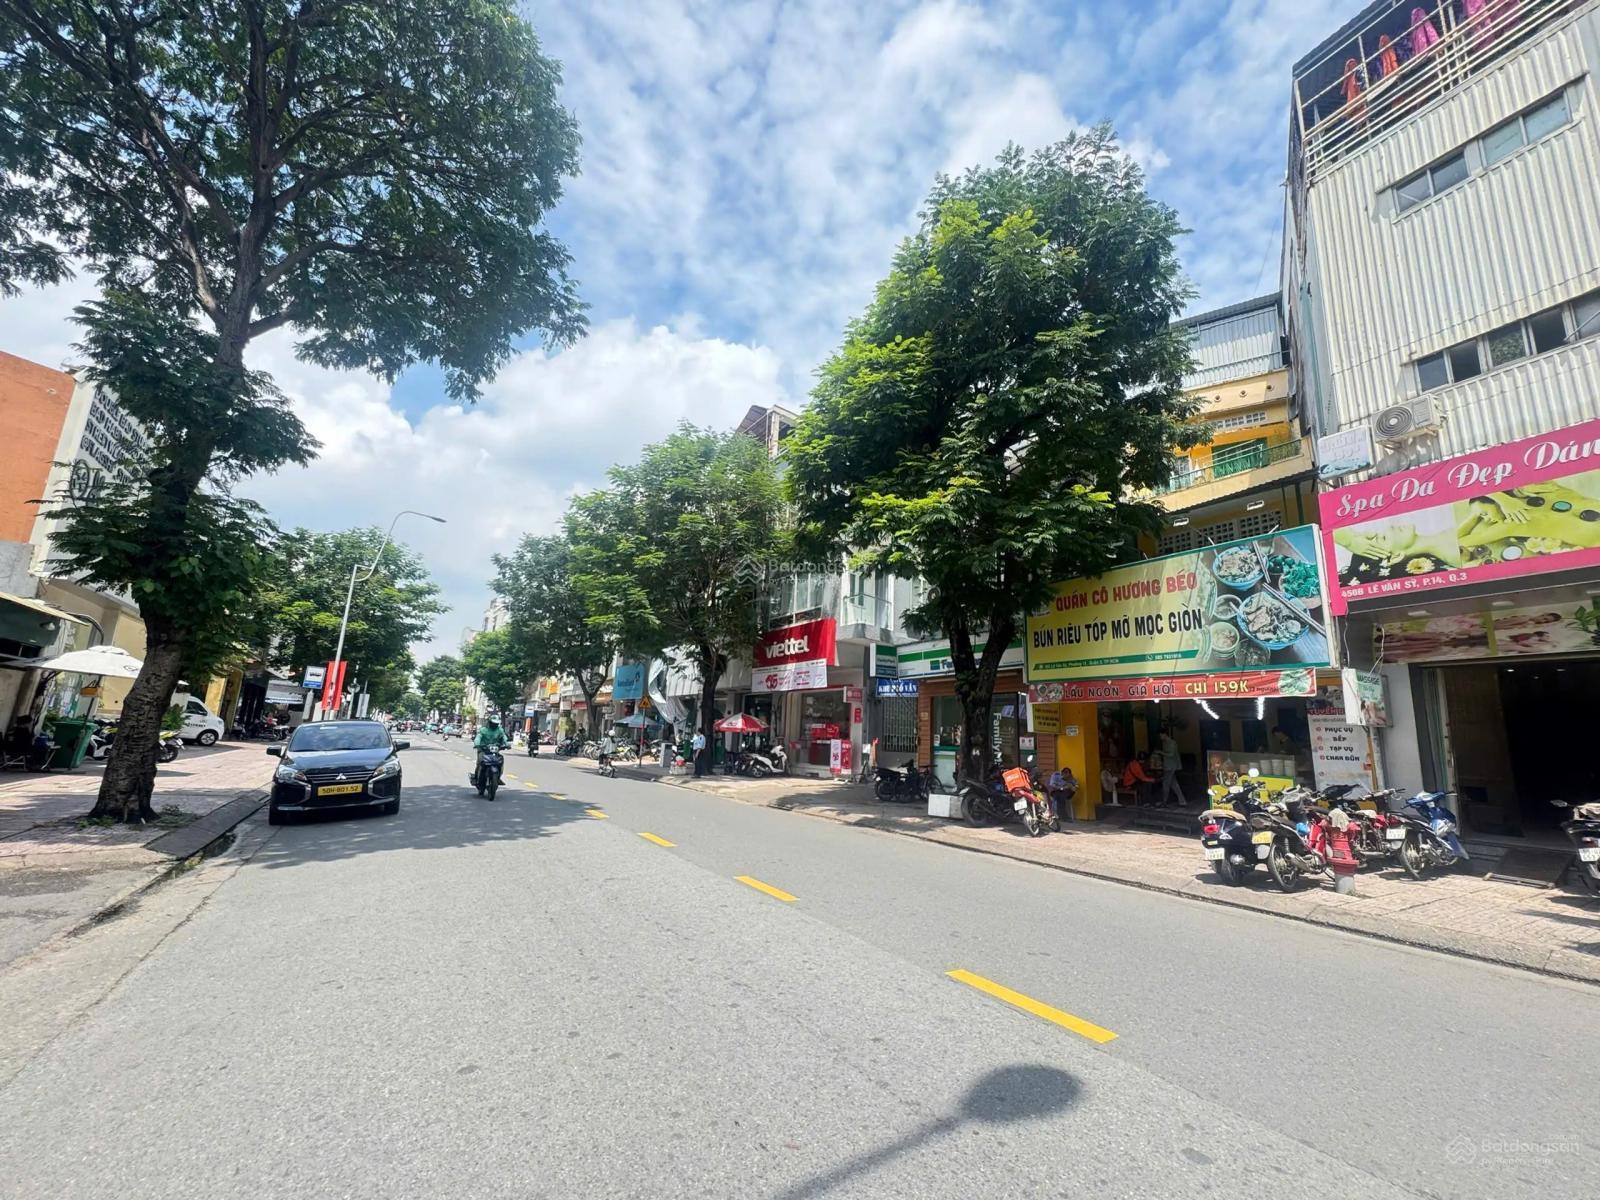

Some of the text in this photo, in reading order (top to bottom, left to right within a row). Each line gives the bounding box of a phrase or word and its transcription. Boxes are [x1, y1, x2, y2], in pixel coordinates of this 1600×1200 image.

[1336, 493, 1385, 518] Spa
[1391, 477, 1437, 503] Da
[1447, 462, 1517, 489] Đẹp
[1092, 586, 1109, 605] CÔ
[1113, 578, 1161, 602] HƯƠNG
[1166, 568, 1198, 593] BÉO
[1033, 603, 1203, 649] BÚN RIÊU TÓP MỠ MỌC GIÒN
[765, 635, 810, 659] viettel
[1214, 679, 1249, 694] 159K
